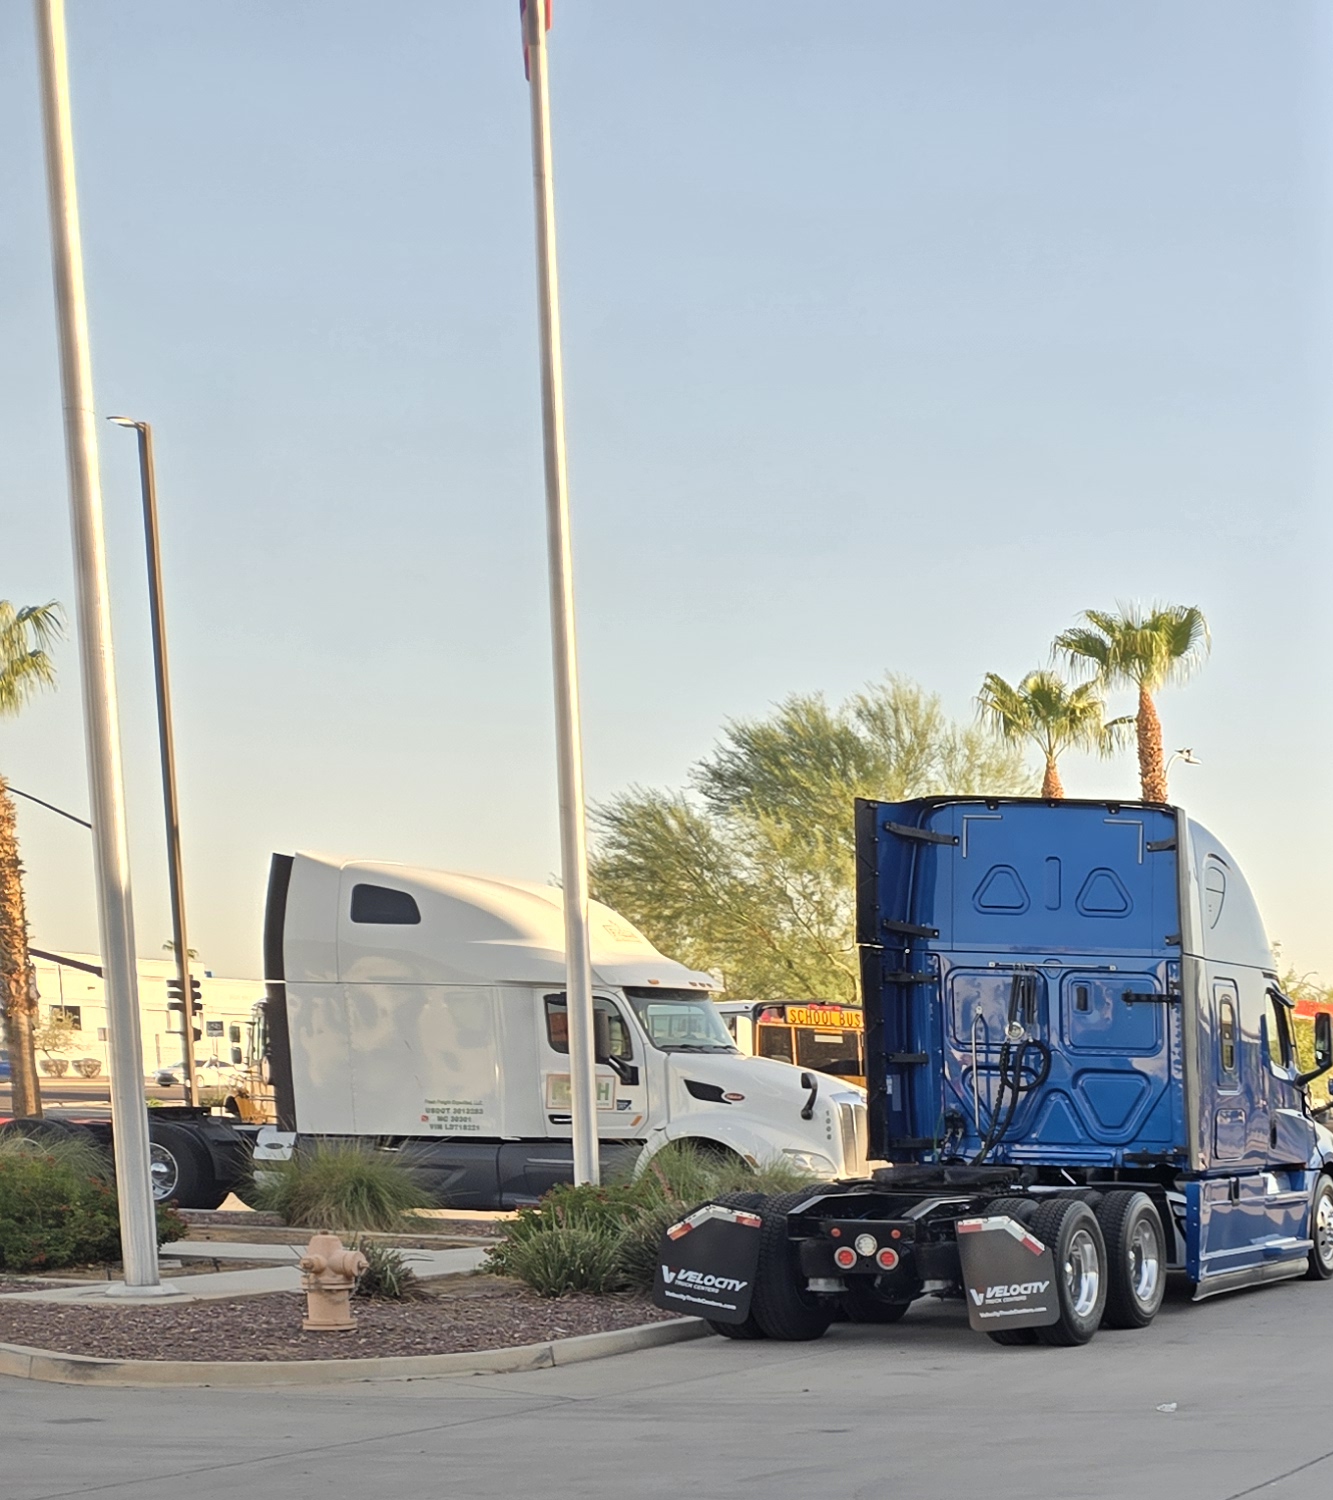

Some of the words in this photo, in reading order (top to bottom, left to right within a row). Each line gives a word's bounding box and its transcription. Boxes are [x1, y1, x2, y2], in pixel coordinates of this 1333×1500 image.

[790, 1009, 835, 1025] SCHOOL
[840, 1011, 861, 1027] BUS
[677, 1268, 748, 1292] VELOCITY
[985, 1280, 1050, 1299] VELOCITY
